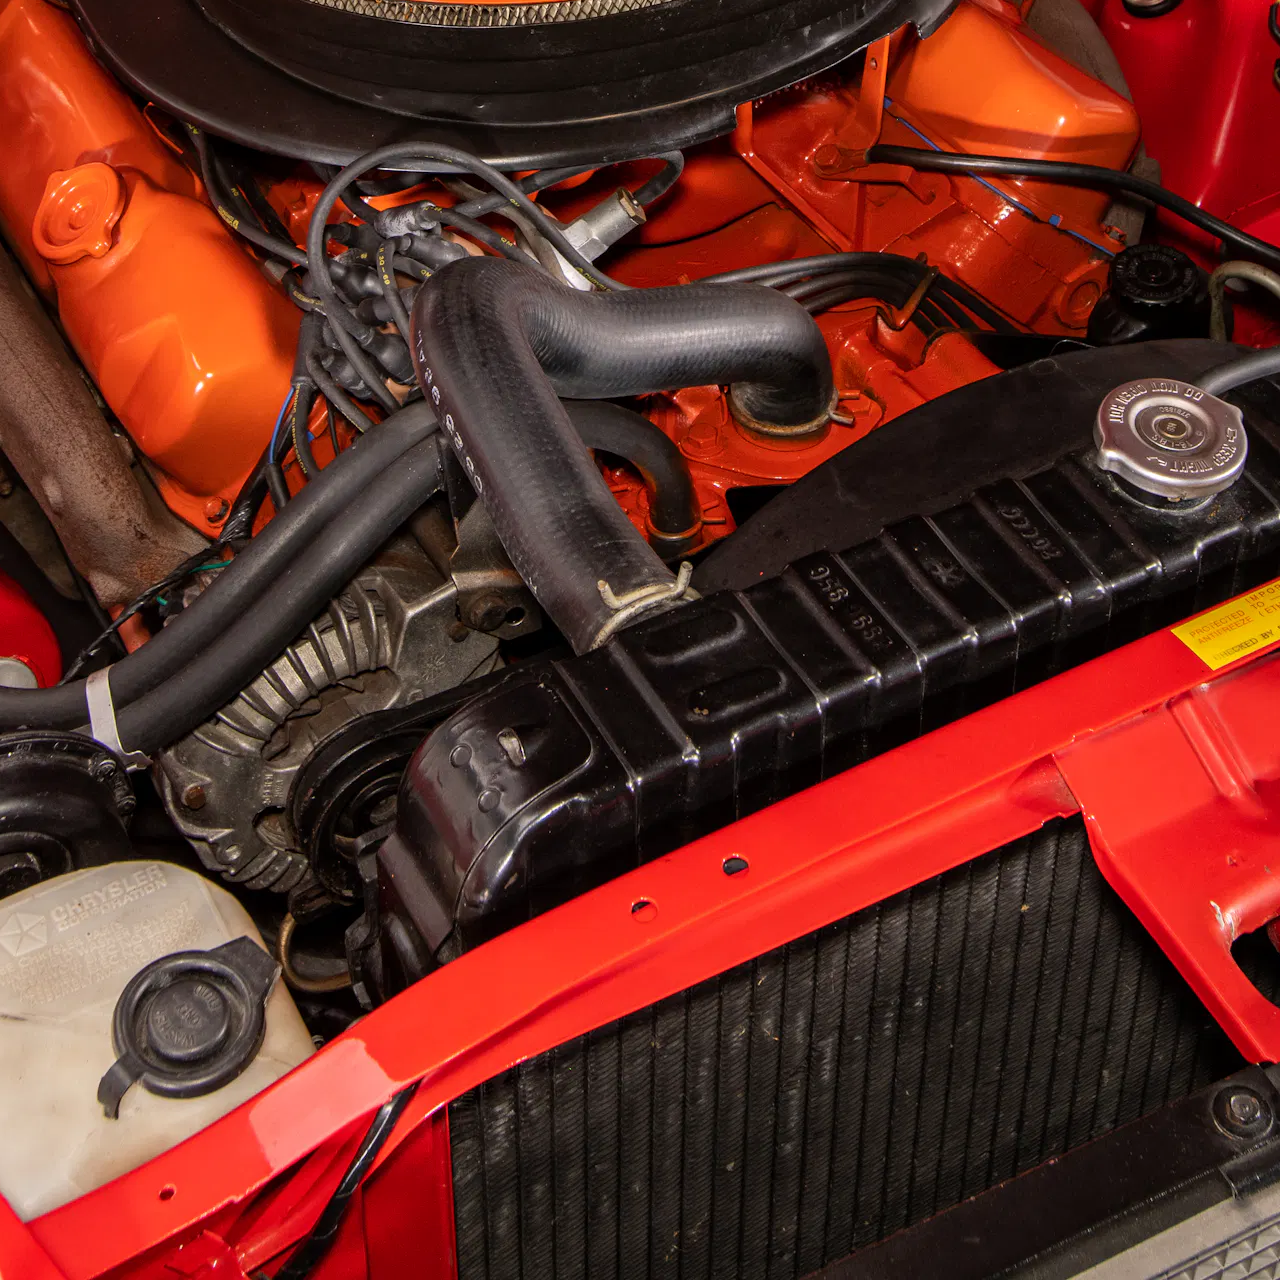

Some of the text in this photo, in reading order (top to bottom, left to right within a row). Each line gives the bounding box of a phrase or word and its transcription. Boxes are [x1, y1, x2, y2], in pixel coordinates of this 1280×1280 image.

[1189, 609, 1246, 638] PROTECTED
[1251, 600, 1265, 610] TO
[1262, 629, 1274, 639] BY
[50, 864, 166, 922] CHRYSLER
[57, 878, 168, 933] CORPORATION
